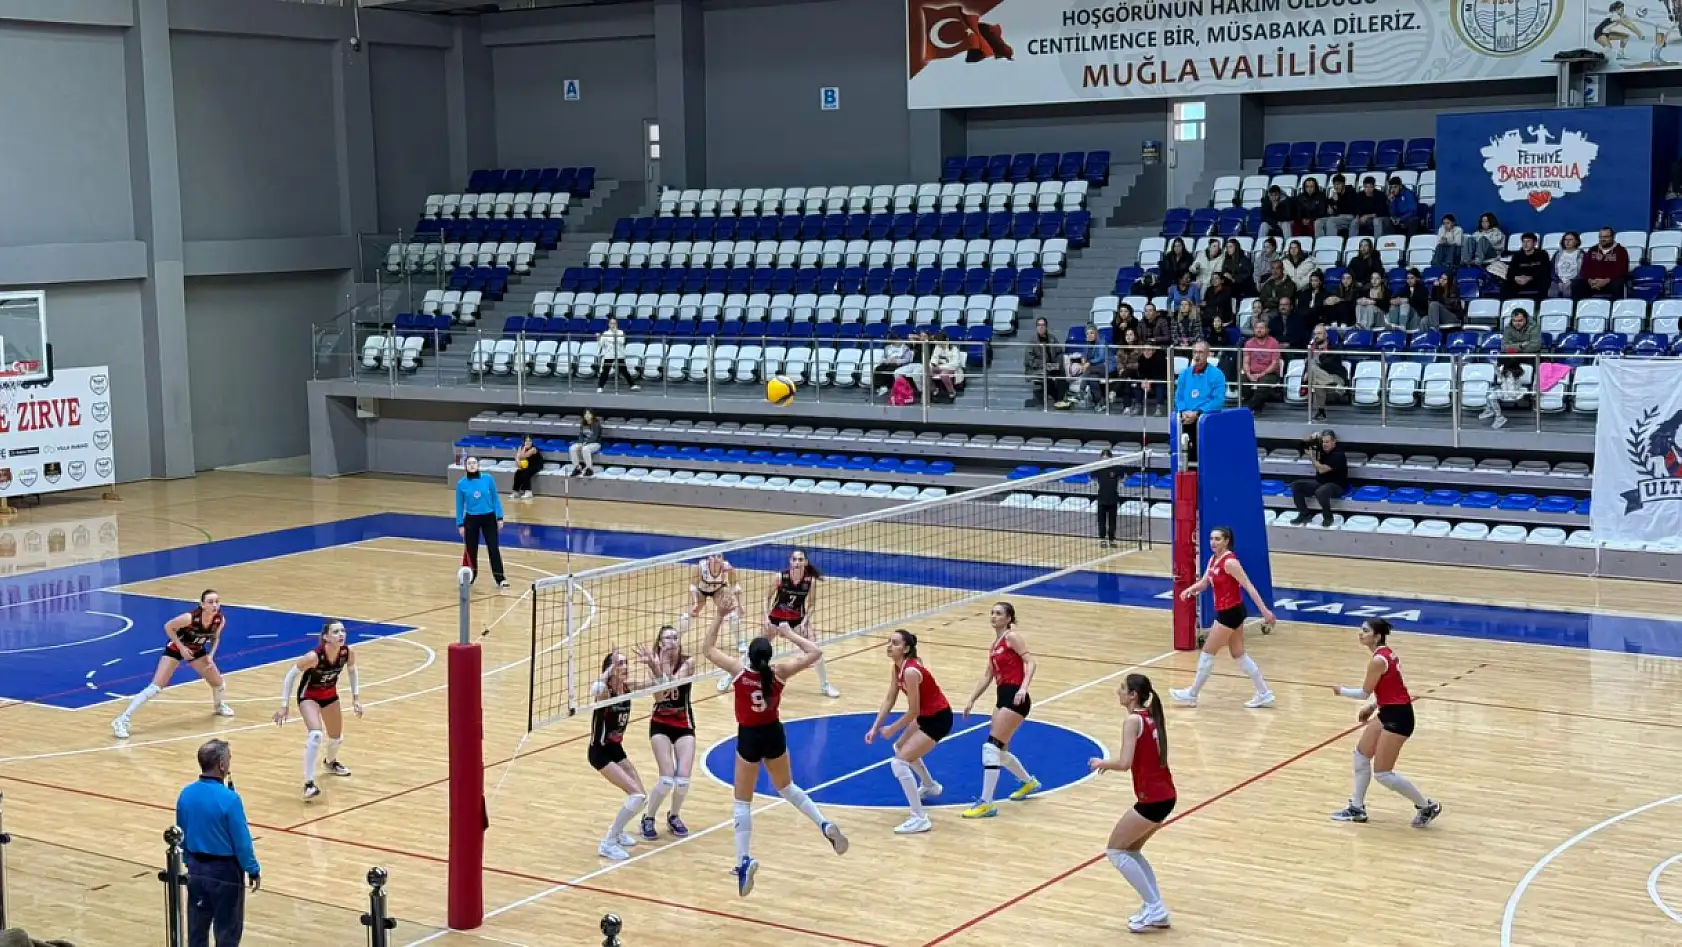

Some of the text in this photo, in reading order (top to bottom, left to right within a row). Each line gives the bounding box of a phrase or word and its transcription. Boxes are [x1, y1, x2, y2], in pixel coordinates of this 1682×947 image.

[1063, 0, 1203, 29] HOŞGÖRÜNÜN
[1028, 9, 1422, 55] CENTİLMENCE BİR, MÜSABAKA DİLERİZ.
[1083, 42, 1355, 88] MUĞLA VALİLİĞİ
[566, 81, 577, 95] A
[824, 89, 837, 105] B
[1497, 163, 1581, 182] BASKETBOLLA
[17, 394, 82, 432] ZİRVE
[1644, 480, 1682, 498] ULT
[750, 689, 769, 713] 9
